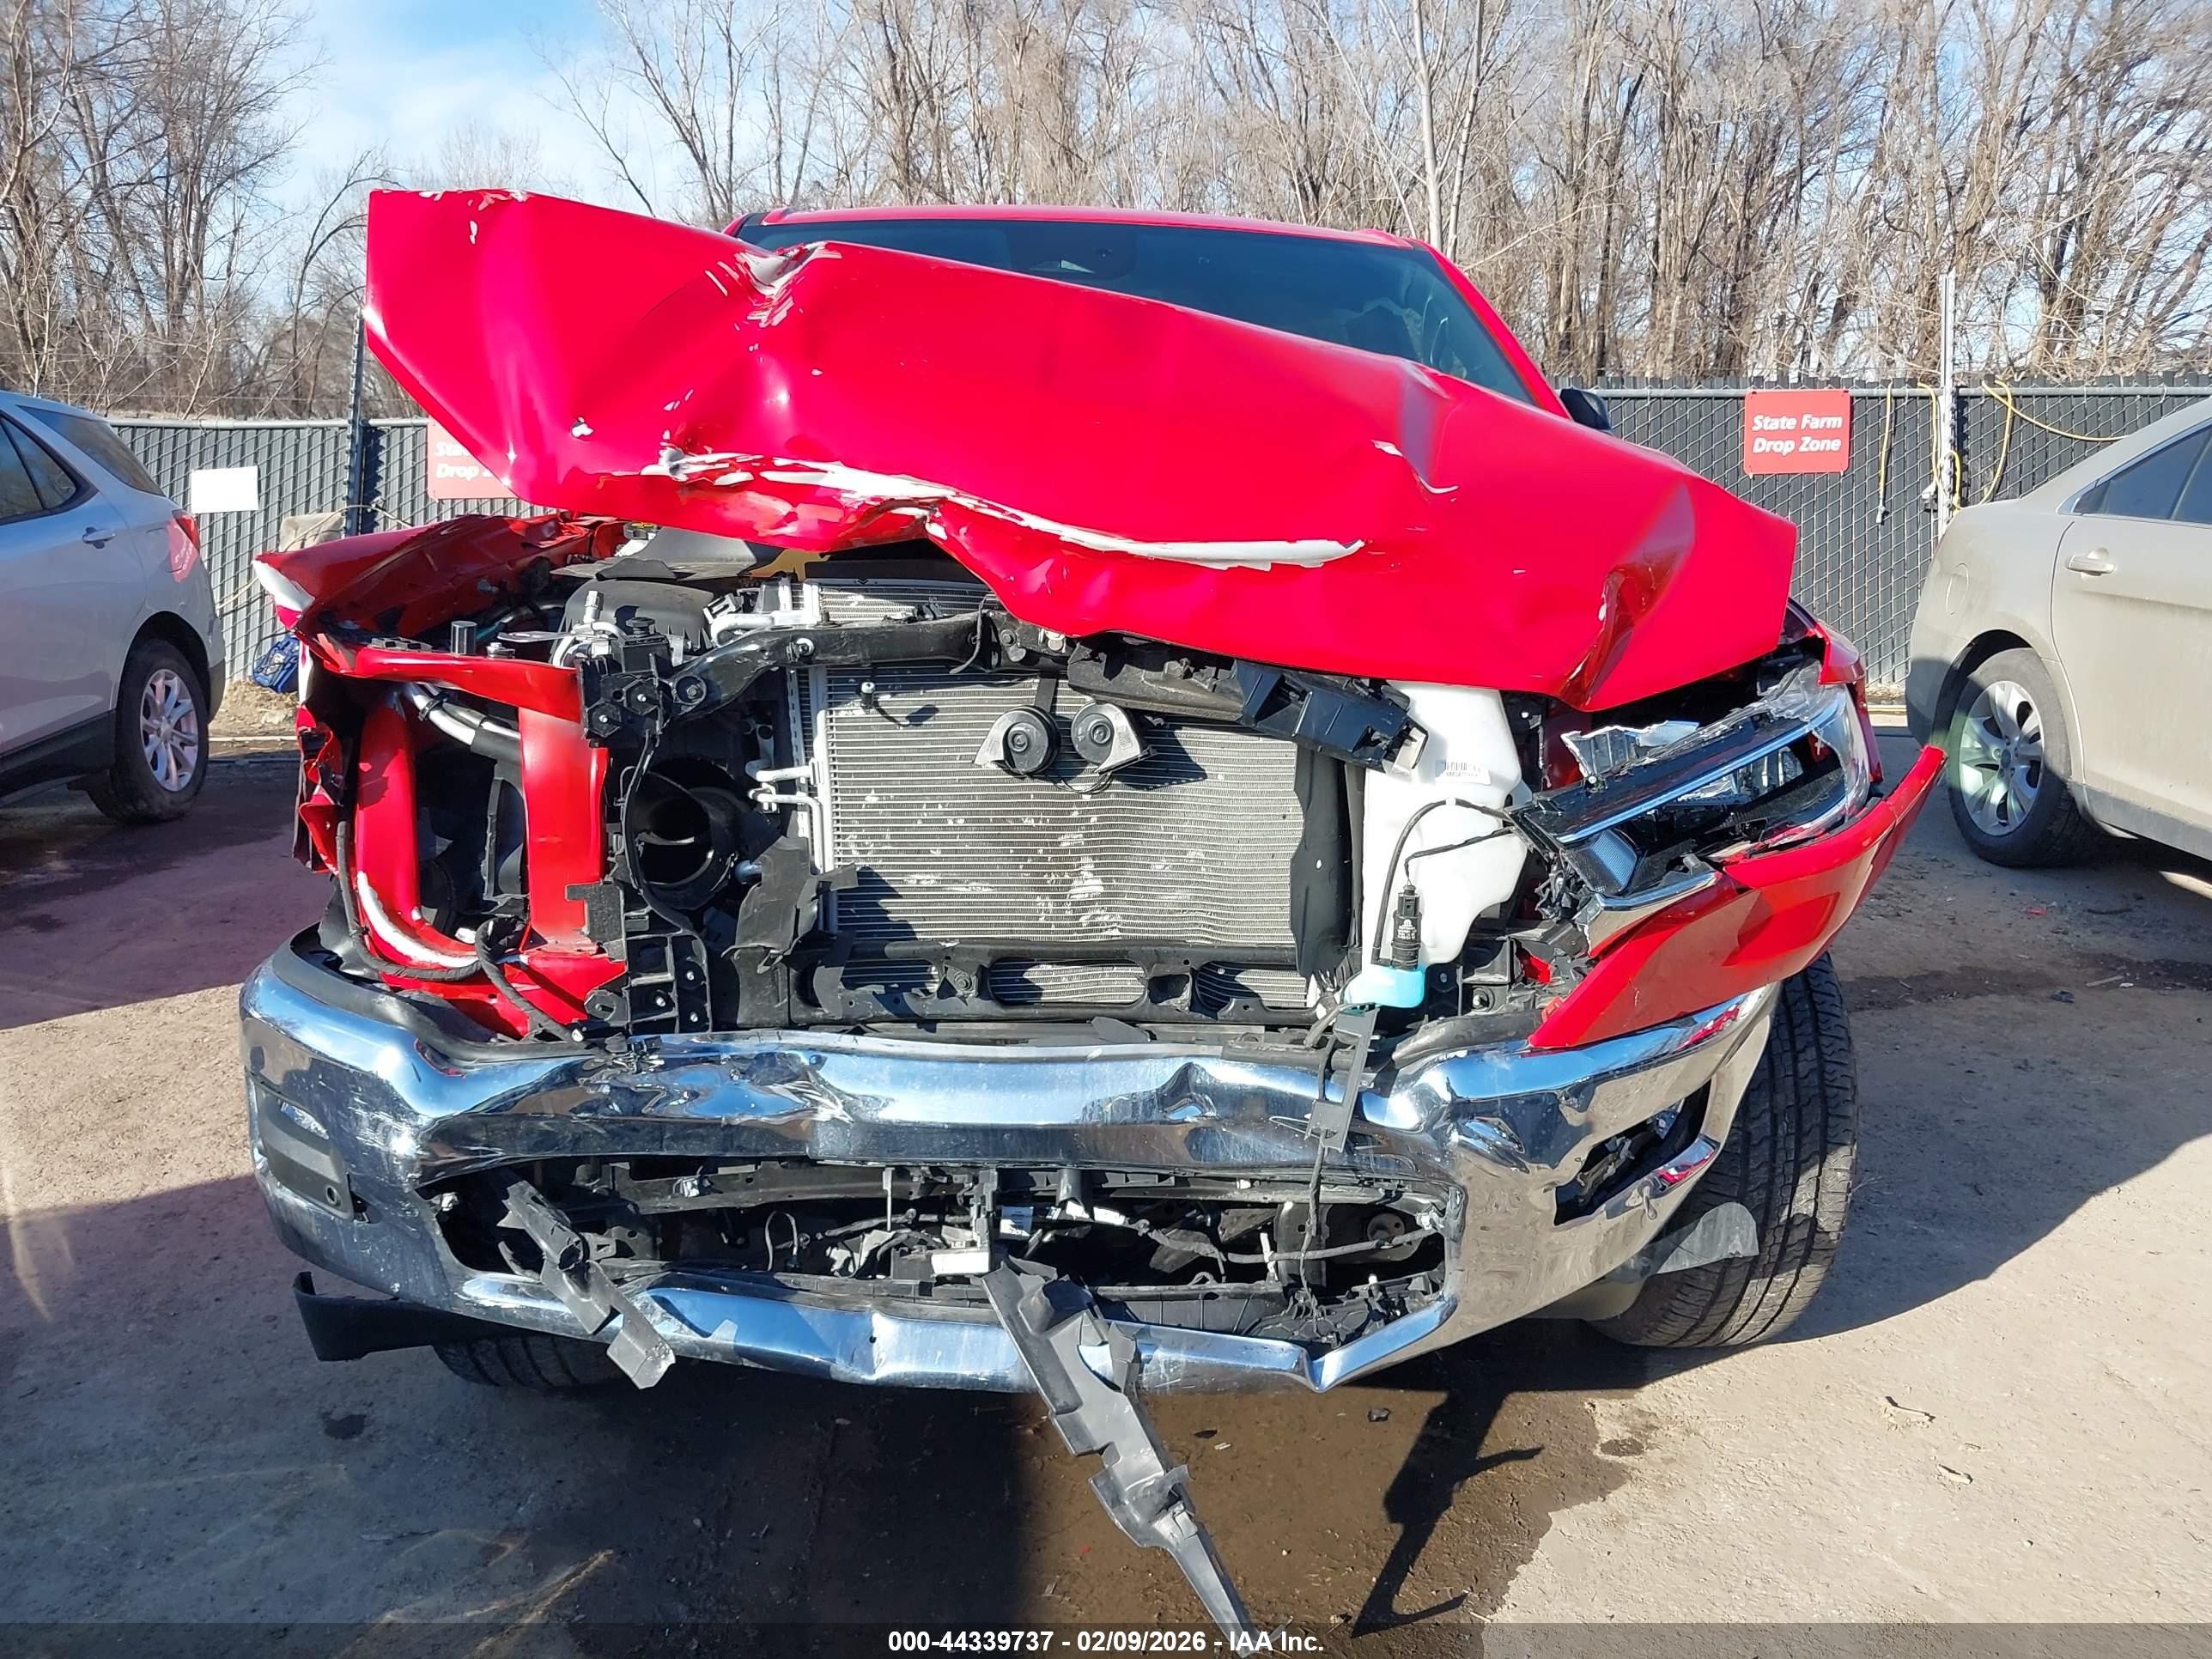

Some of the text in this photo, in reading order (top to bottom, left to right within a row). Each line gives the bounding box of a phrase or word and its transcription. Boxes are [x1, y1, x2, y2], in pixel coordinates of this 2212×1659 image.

[1752, 413, 1843, 431] State Farm
[1753, 436, 1842, 457] Drop Zone
[436, 463, 480, 482] Drop
